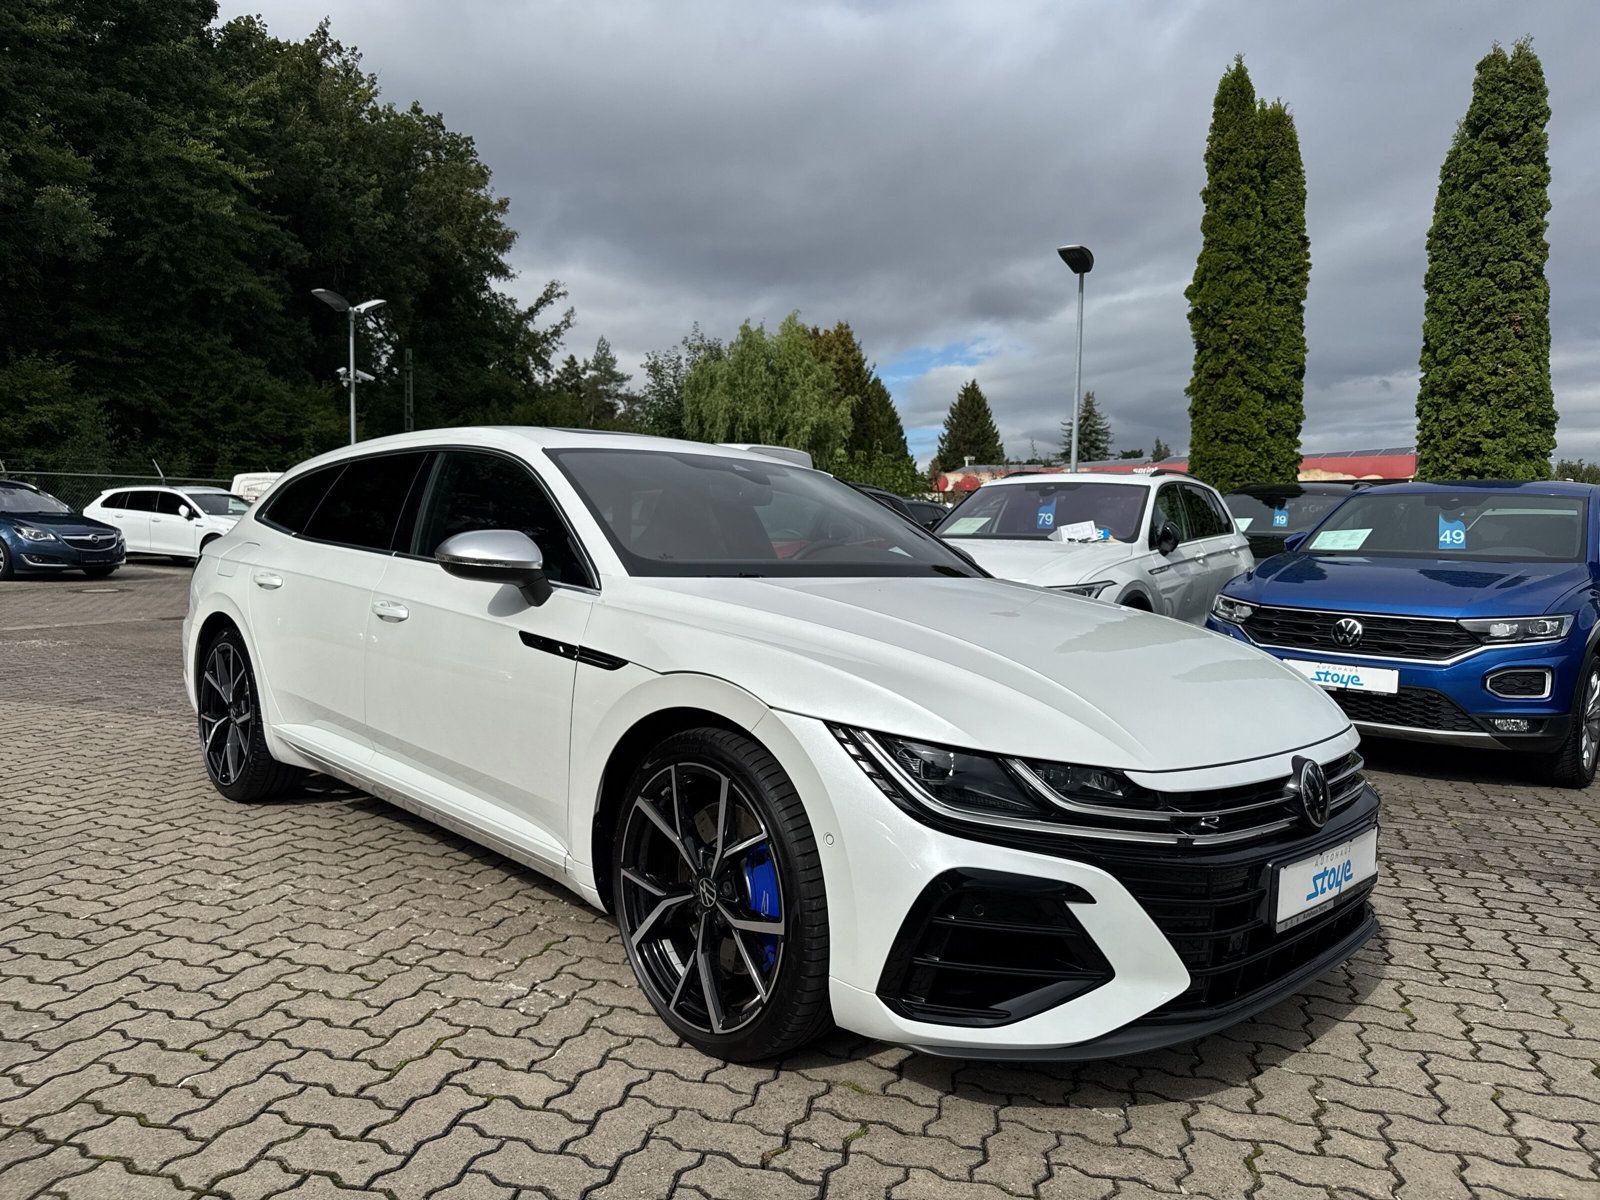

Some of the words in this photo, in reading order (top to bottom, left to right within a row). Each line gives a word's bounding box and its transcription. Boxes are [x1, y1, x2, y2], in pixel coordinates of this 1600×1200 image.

[1038, 513, 1054, 525] 79
[1274, 515, 1287, 525] 19
[1439, 529, 1465, 544] 49
[1316, 664, 1359, 673] AUTOHAUS
[1314, 844, 1352, 867] AUTOHAUS
